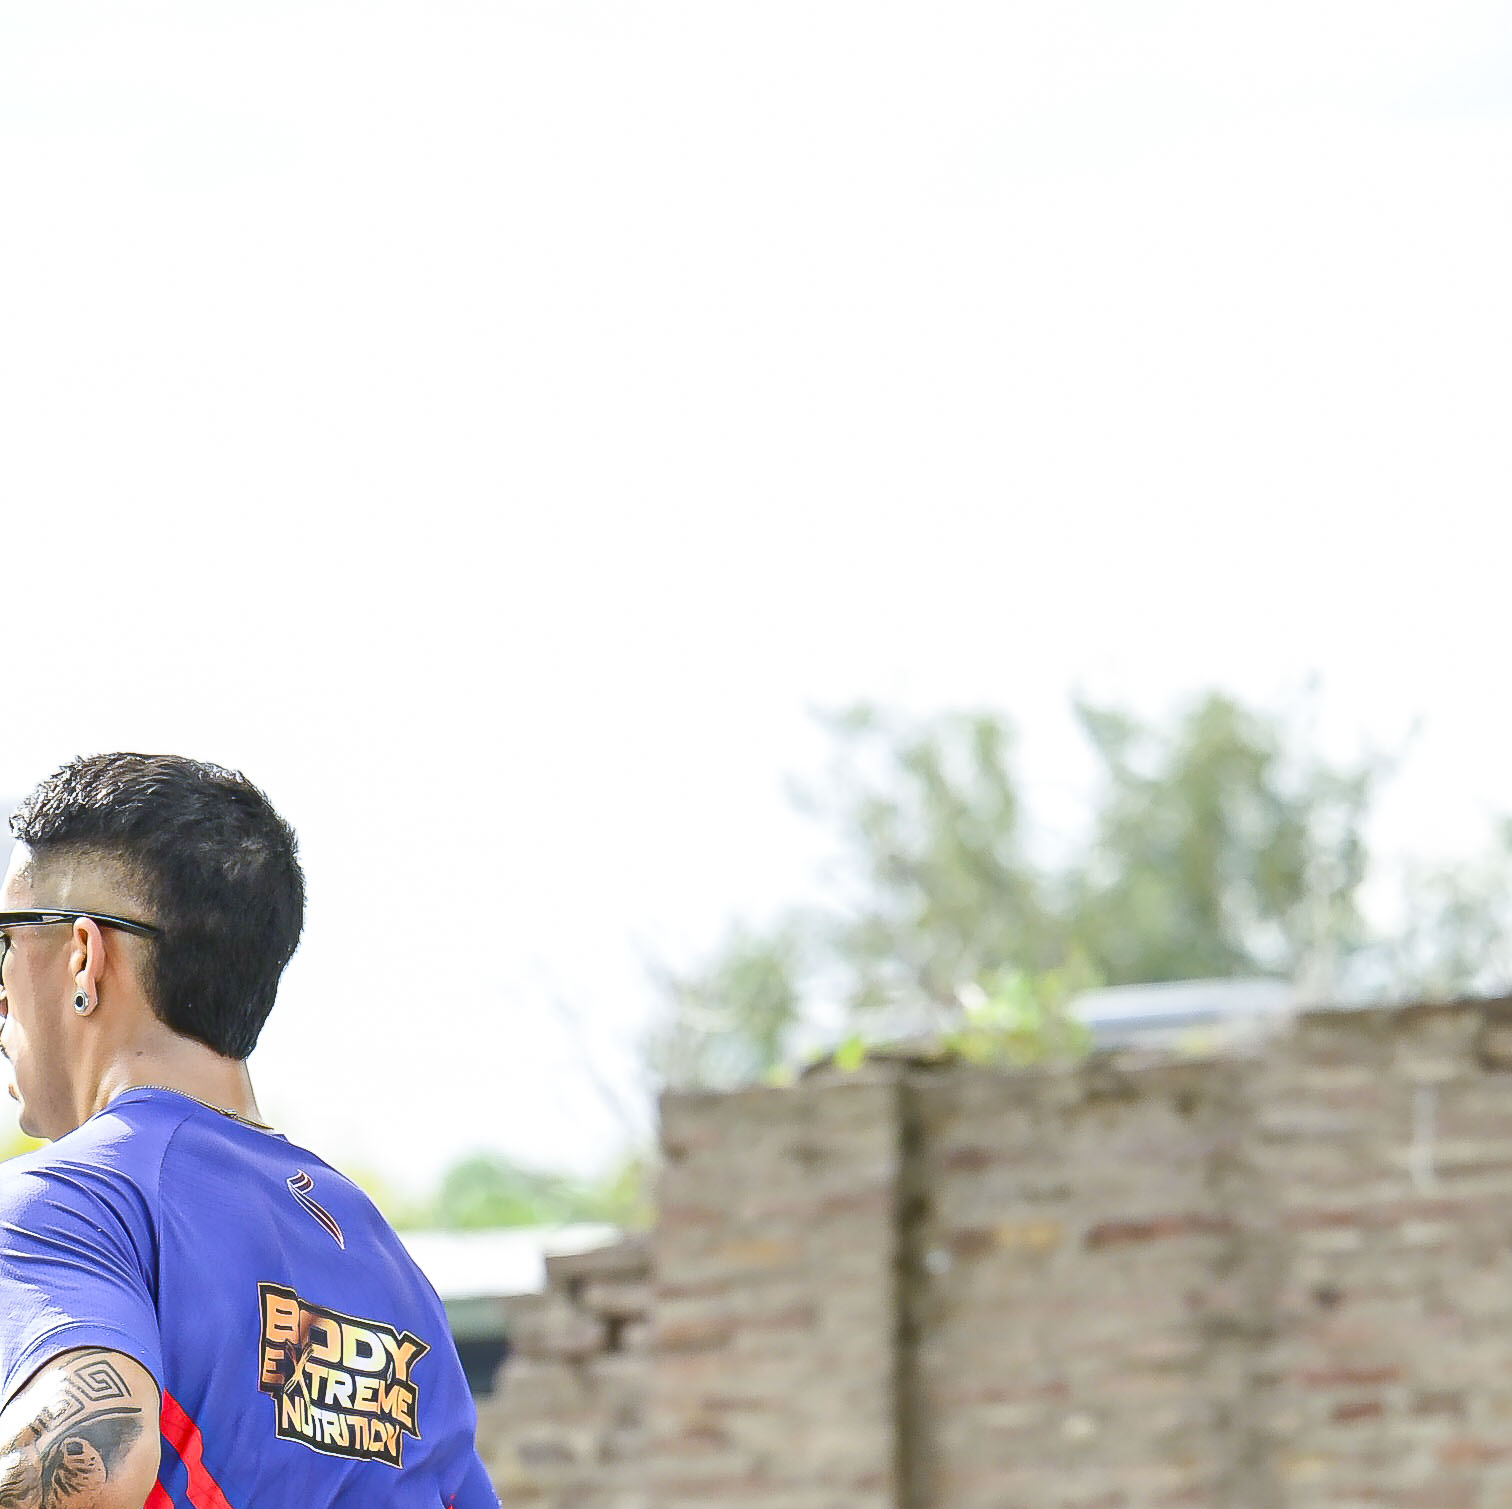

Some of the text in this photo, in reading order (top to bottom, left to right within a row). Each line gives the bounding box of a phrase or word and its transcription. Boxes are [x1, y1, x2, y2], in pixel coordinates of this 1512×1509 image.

[265, 1293, 418, 1381] BODY
[261, 1342, 413, 1429] EXTREME
[282, 1393, 400, 1457] NUTRITION
